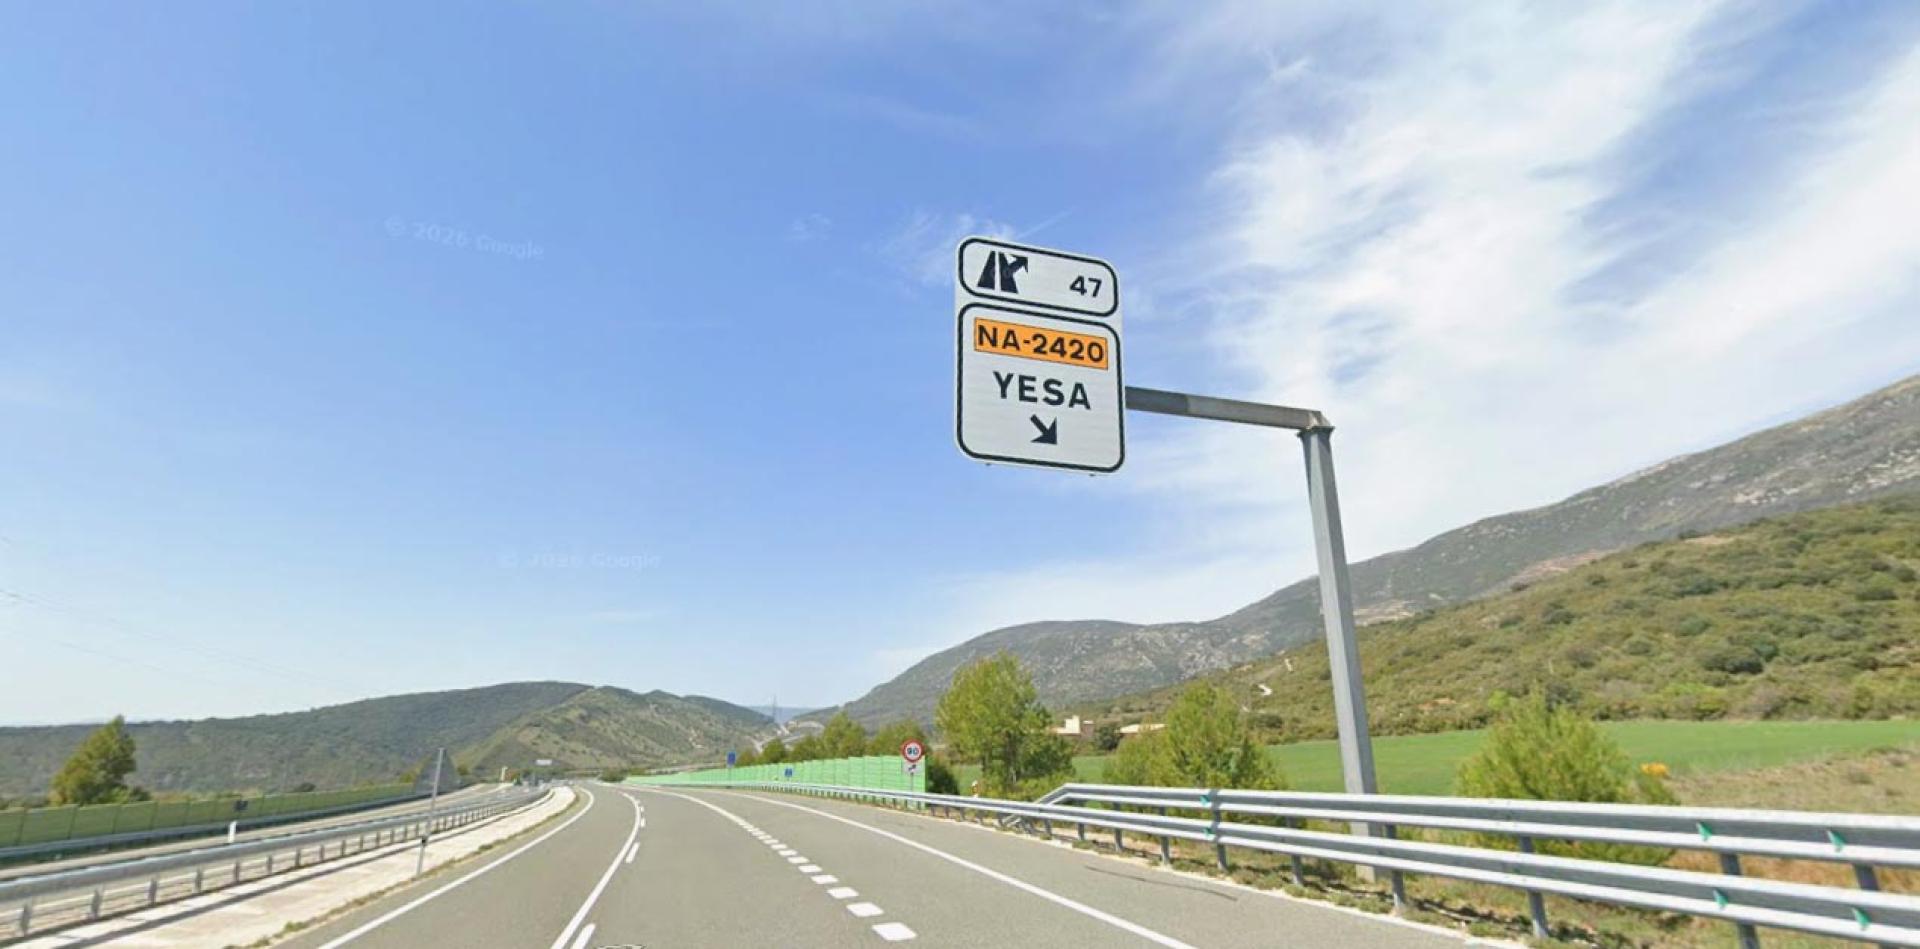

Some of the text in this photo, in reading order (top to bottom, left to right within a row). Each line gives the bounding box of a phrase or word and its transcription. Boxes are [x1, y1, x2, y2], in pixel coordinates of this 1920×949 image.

[1069, 276, 1103, 298] 47
[978, 324, 1104, 363] NA-2420
[992, 370, 1091, 410] YESA
